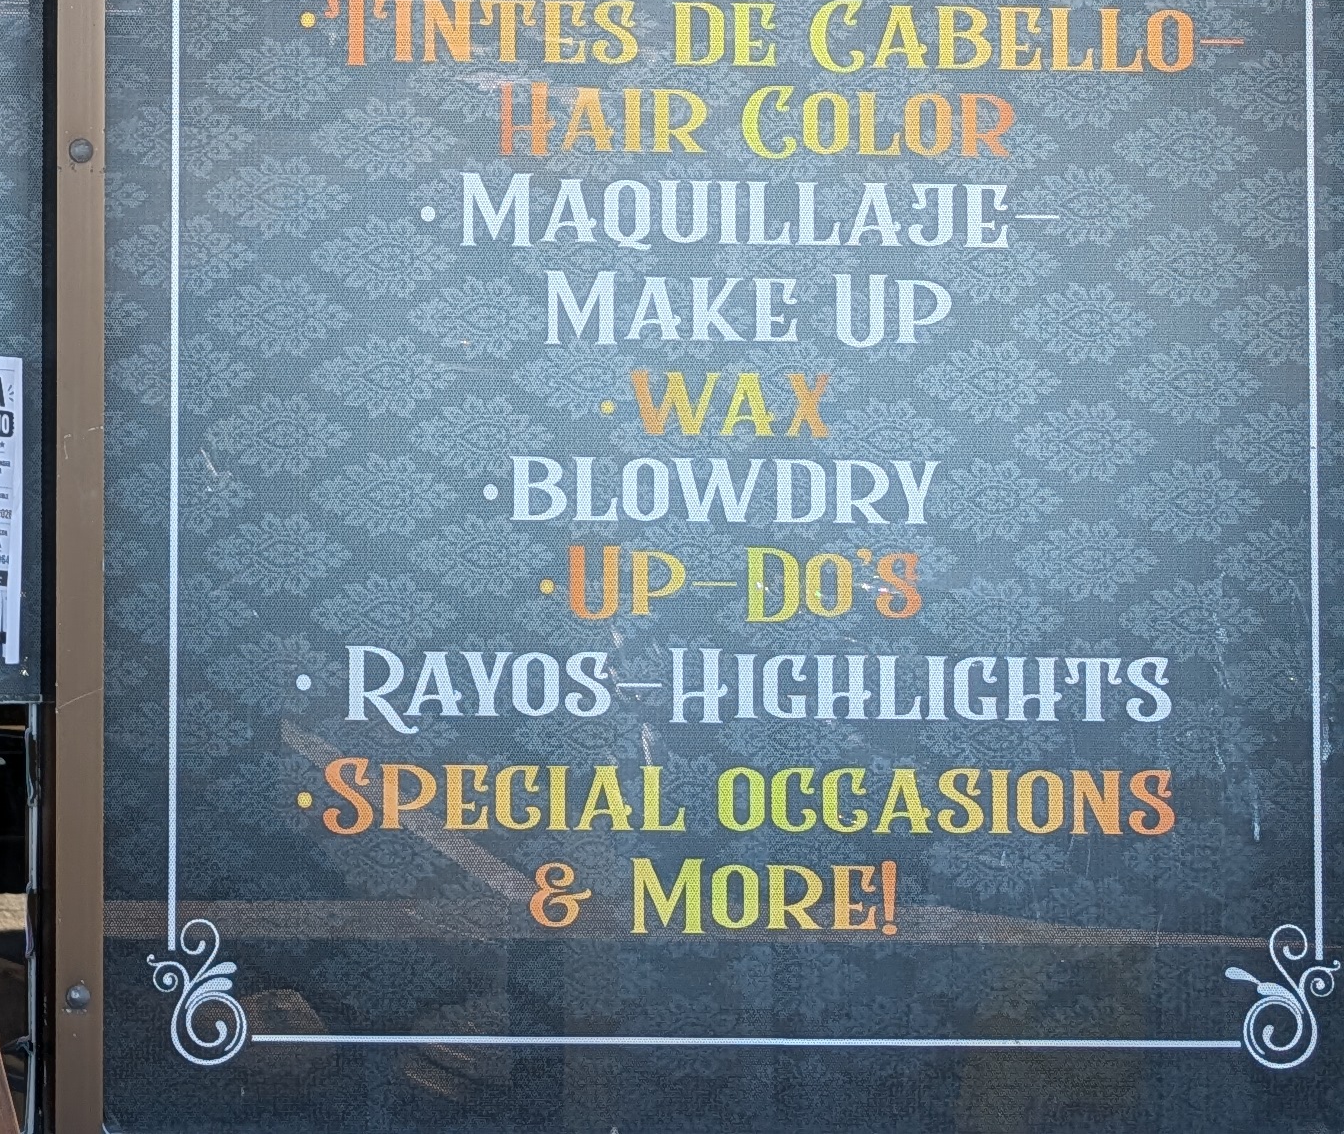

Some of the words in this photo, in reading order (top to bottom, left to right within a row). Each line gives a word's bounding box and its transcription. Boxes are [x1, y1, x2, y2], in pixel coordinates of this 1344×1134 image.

[673, 0, 776, 68] DE
[499, 81, 710, 159] HAIR
[741, 85, 1015, 161] COLOR
[543, 269, 800, 345] MAKE
[834, 273, 954, 348] UP
[628, 368, 831, 439] WAX
[508, 454, 941, 525] BLOWDRY
[321, 757, 687, 836] SPECIAL
[717, 765, 1176, 836] OCCASIONS
[528, 861, 592, 930] &
[628, 857, 899, 936] MORE!
